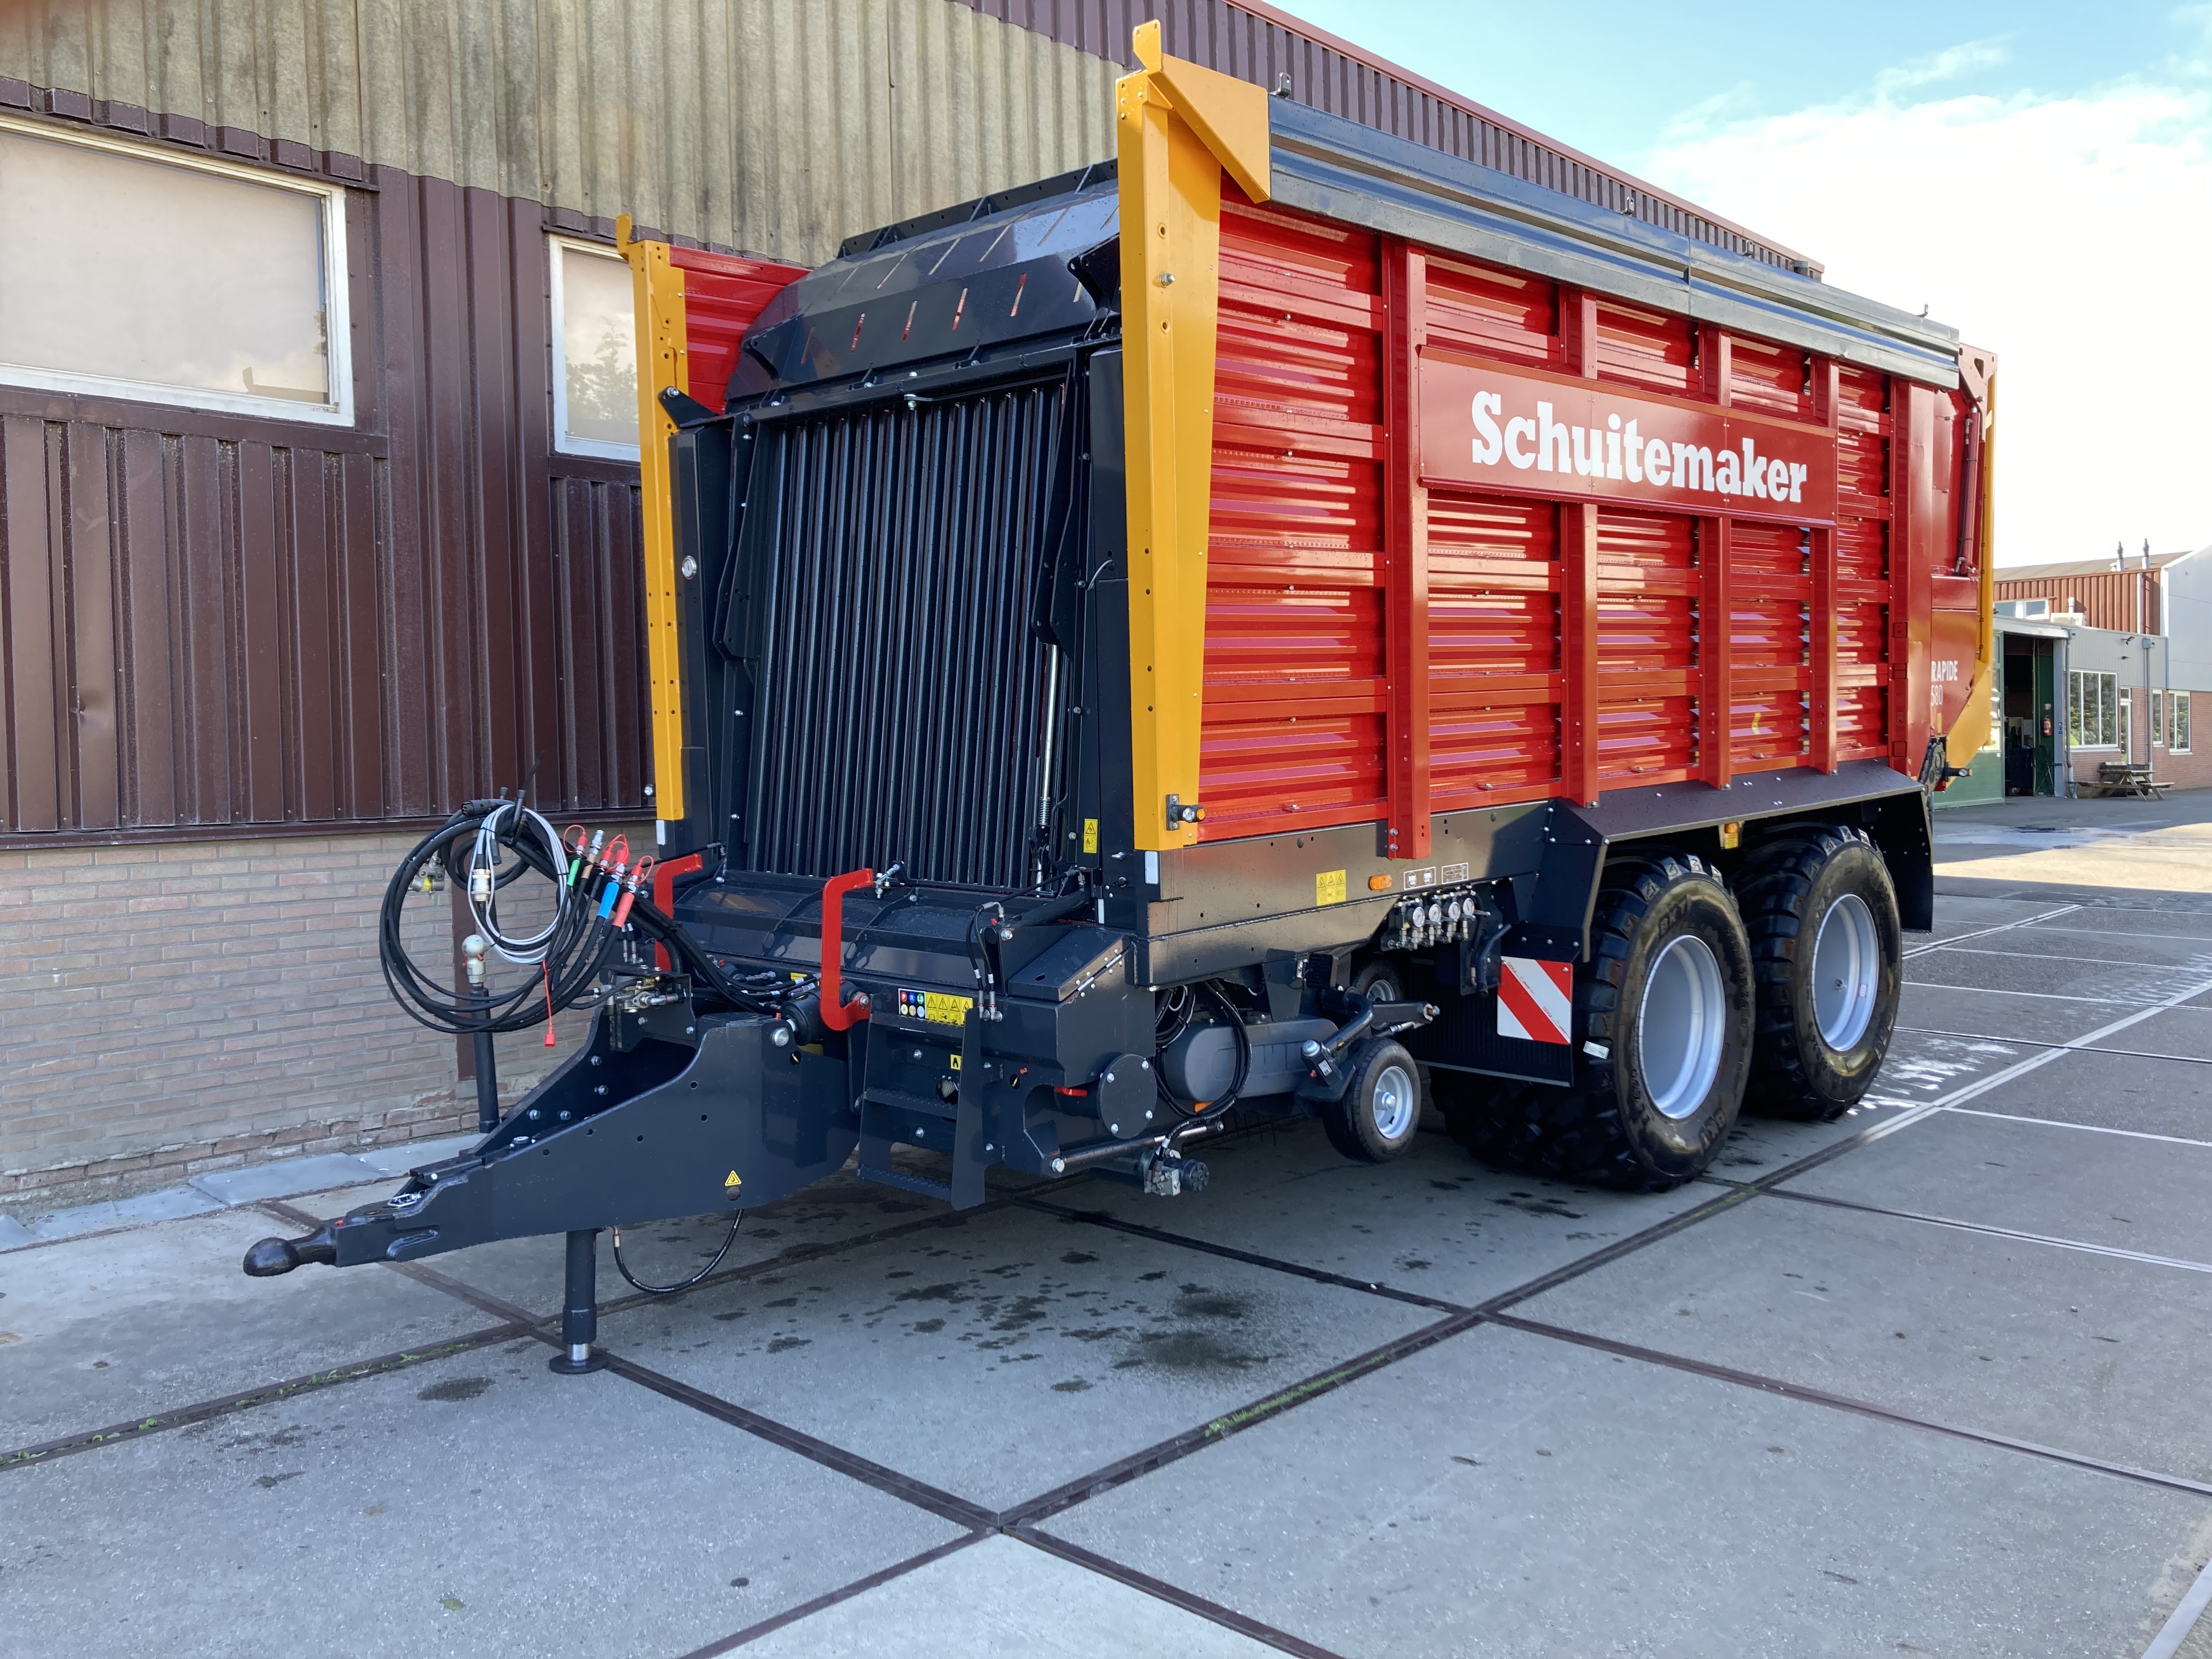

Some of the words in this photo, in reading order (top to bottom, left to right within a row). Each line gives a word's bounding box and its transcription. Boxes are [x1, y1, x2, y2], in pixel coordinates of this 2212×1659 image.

[1472, 390, 1807, 503] Schuitemaker
[1931, 660, 1958, 682] RAPIDE
[1930, 684, 1943, 706] 580
